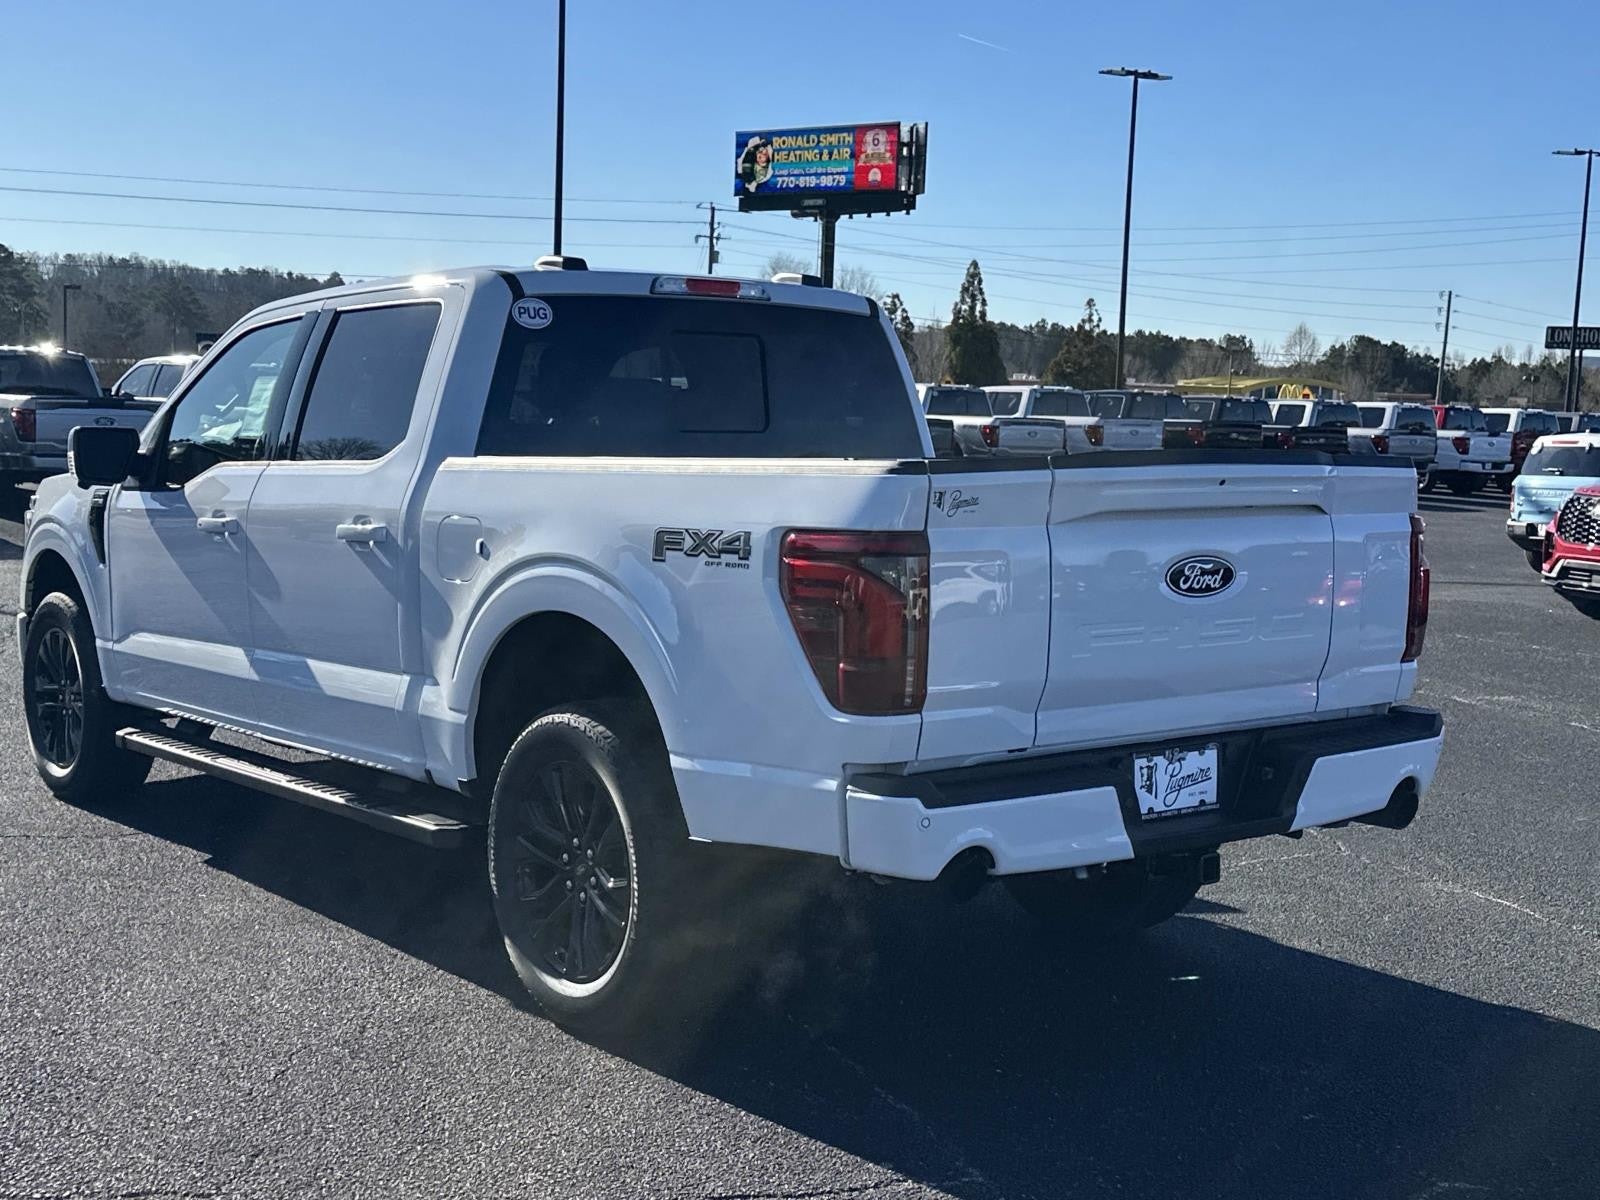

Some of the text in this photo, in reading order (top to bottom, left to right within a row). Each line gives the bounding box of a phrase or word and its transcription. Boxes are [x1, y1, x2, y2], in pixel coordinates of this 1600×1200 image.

[772, 132, 853, 149] RONALD SMITH
[872, 133, 880, 147] 6
[774, 149, 820, 163] HEATING
[821, 148, 830, 161] &
[831, 147, 851, 160] AIR
[776, 174, 846, 188] 770-819-9879
[518, 306, 547, 320] PUG
[1547, 328, 1600, 344] LONHO
[652, 527, 752, 562] FX4
[1180, 562, 1224, 590] Ford
[1163, 760, 1212, 808] Pugmire
